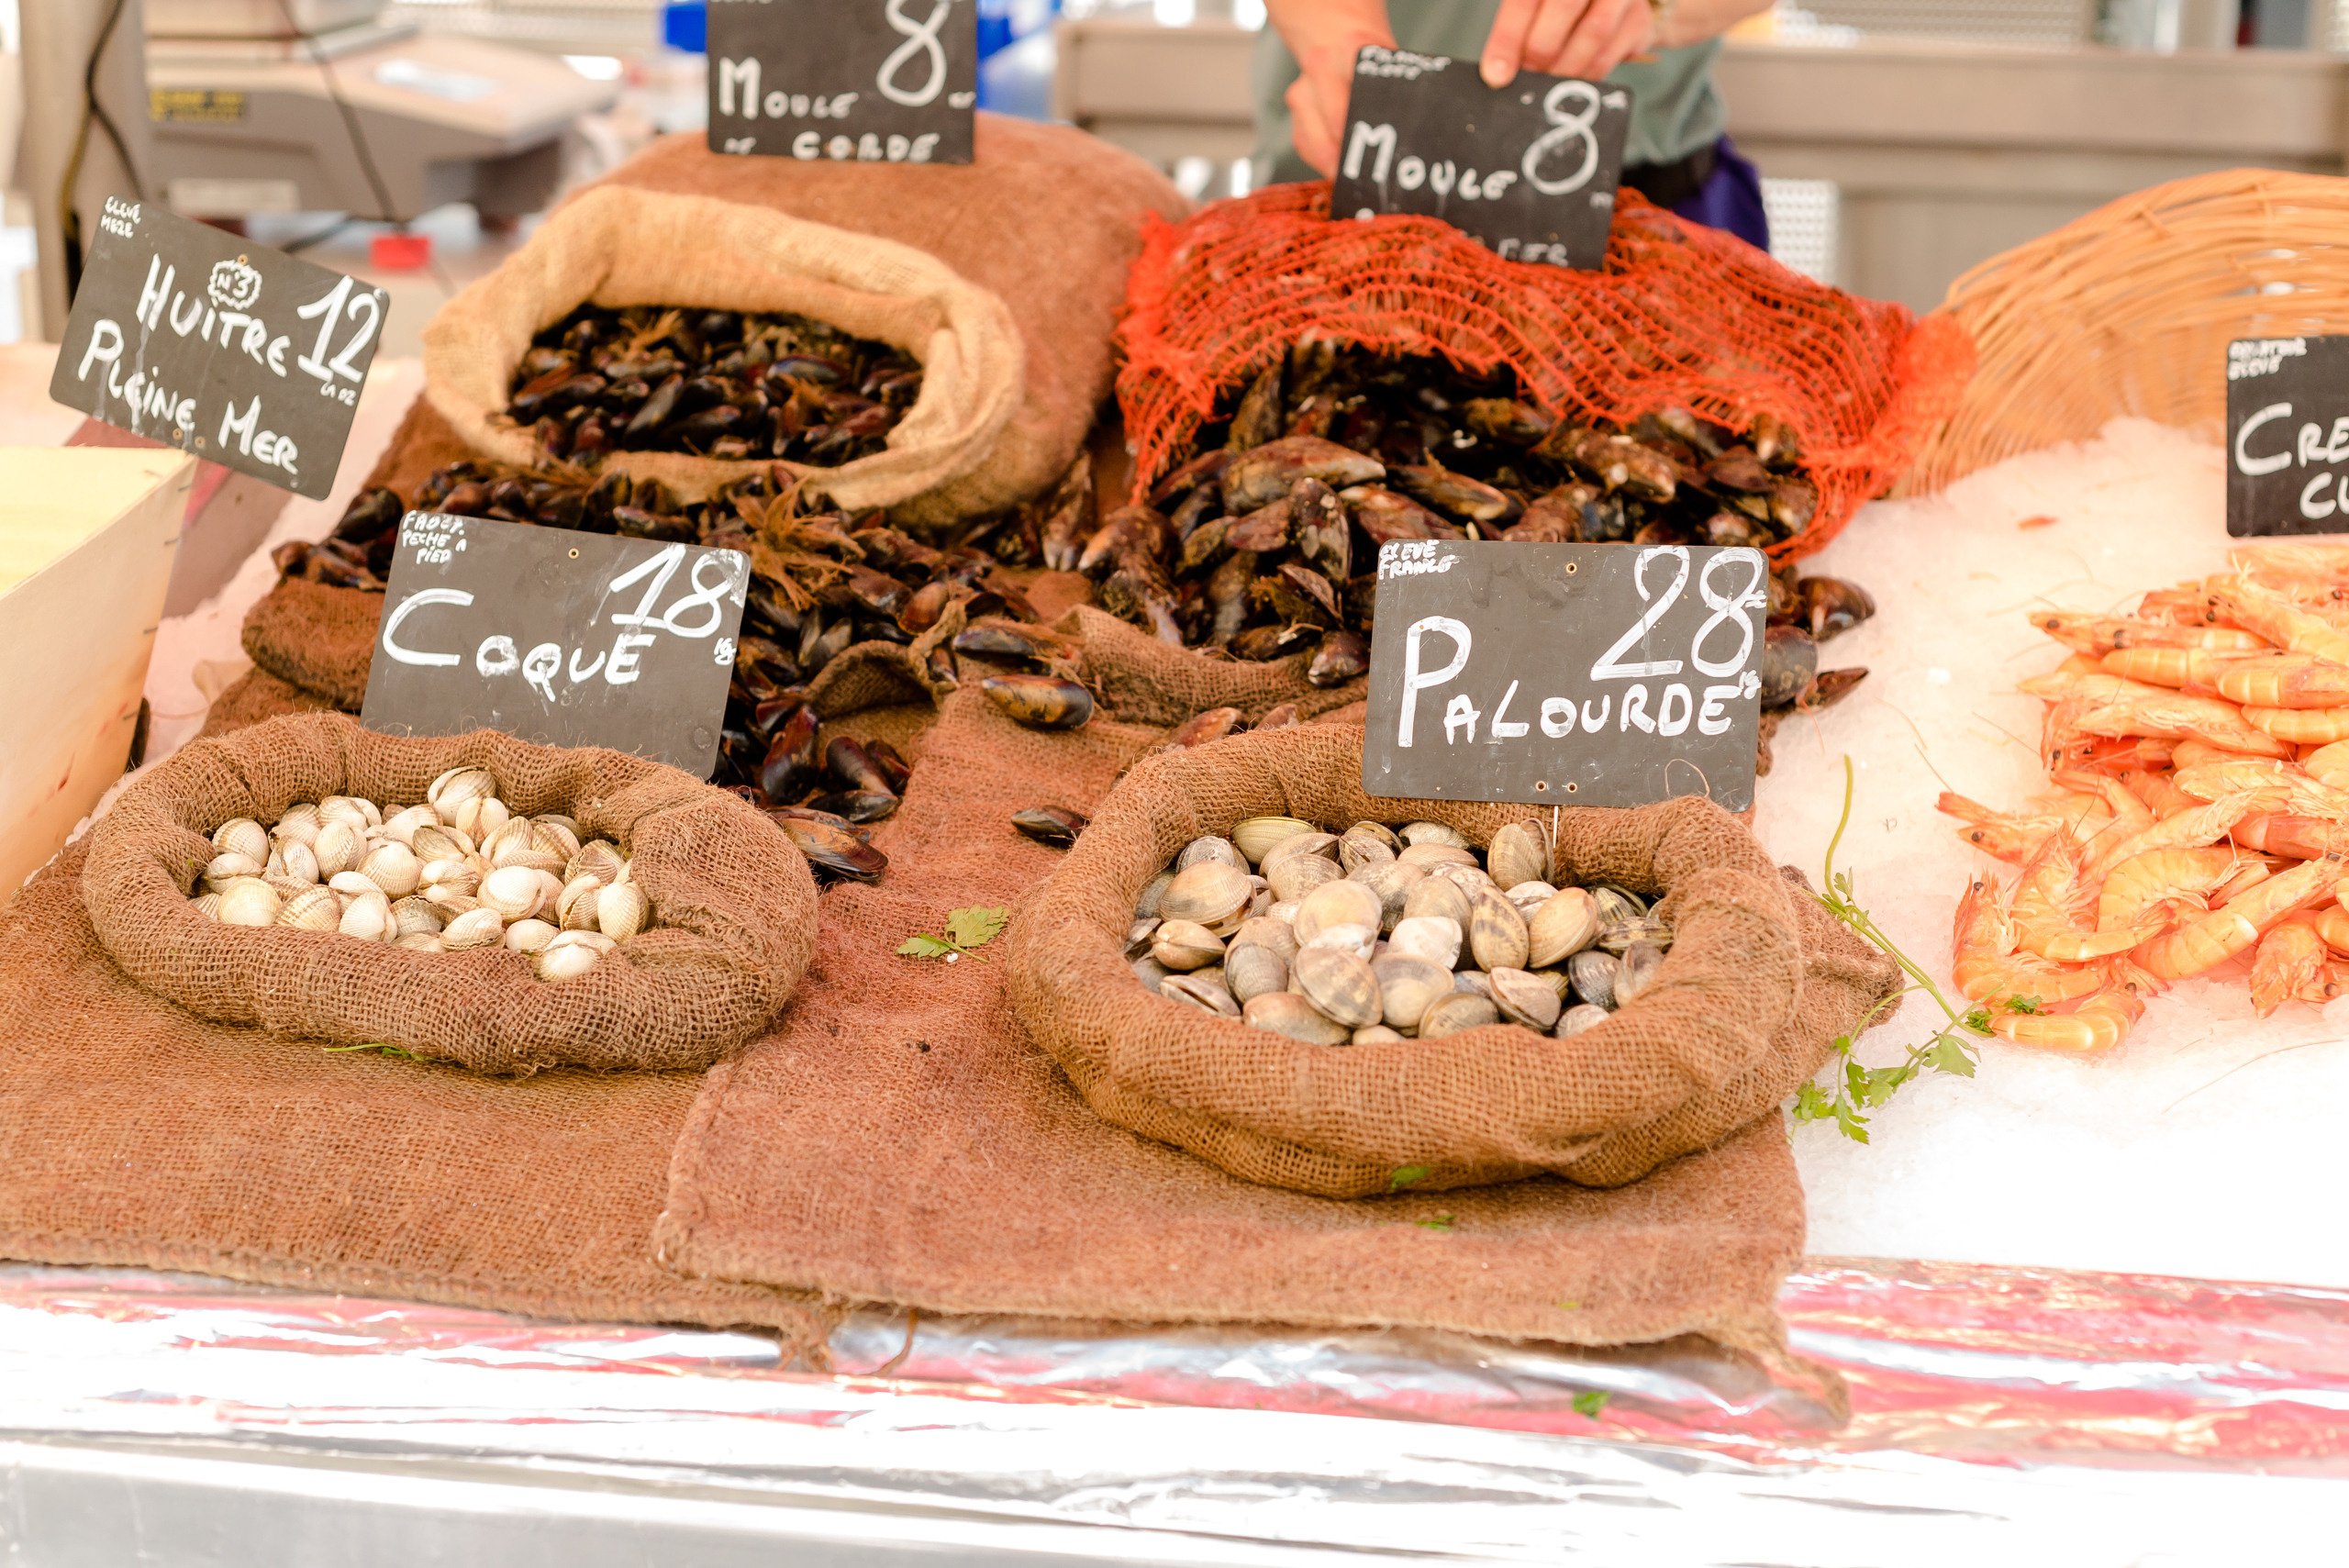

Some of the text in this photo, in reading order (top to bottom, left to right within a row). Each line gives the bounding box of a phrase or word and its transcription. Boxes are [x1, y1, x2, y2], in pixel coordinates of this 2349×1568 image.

[876, 0, 952, 107] 8
[792, 131, 941, 162] CORDE
[1342, 120, 1519, 201] MOULE
[1521, 80, 1601, 196] 8
[136, 253, 381, 384] HUITRE 12
[217, 395, 298, 475] MER
[609, 543, 743, 639] 18
[383, 587, 657, 703] COQUE
[1397, 616, 1742, 749] PALOURDE
